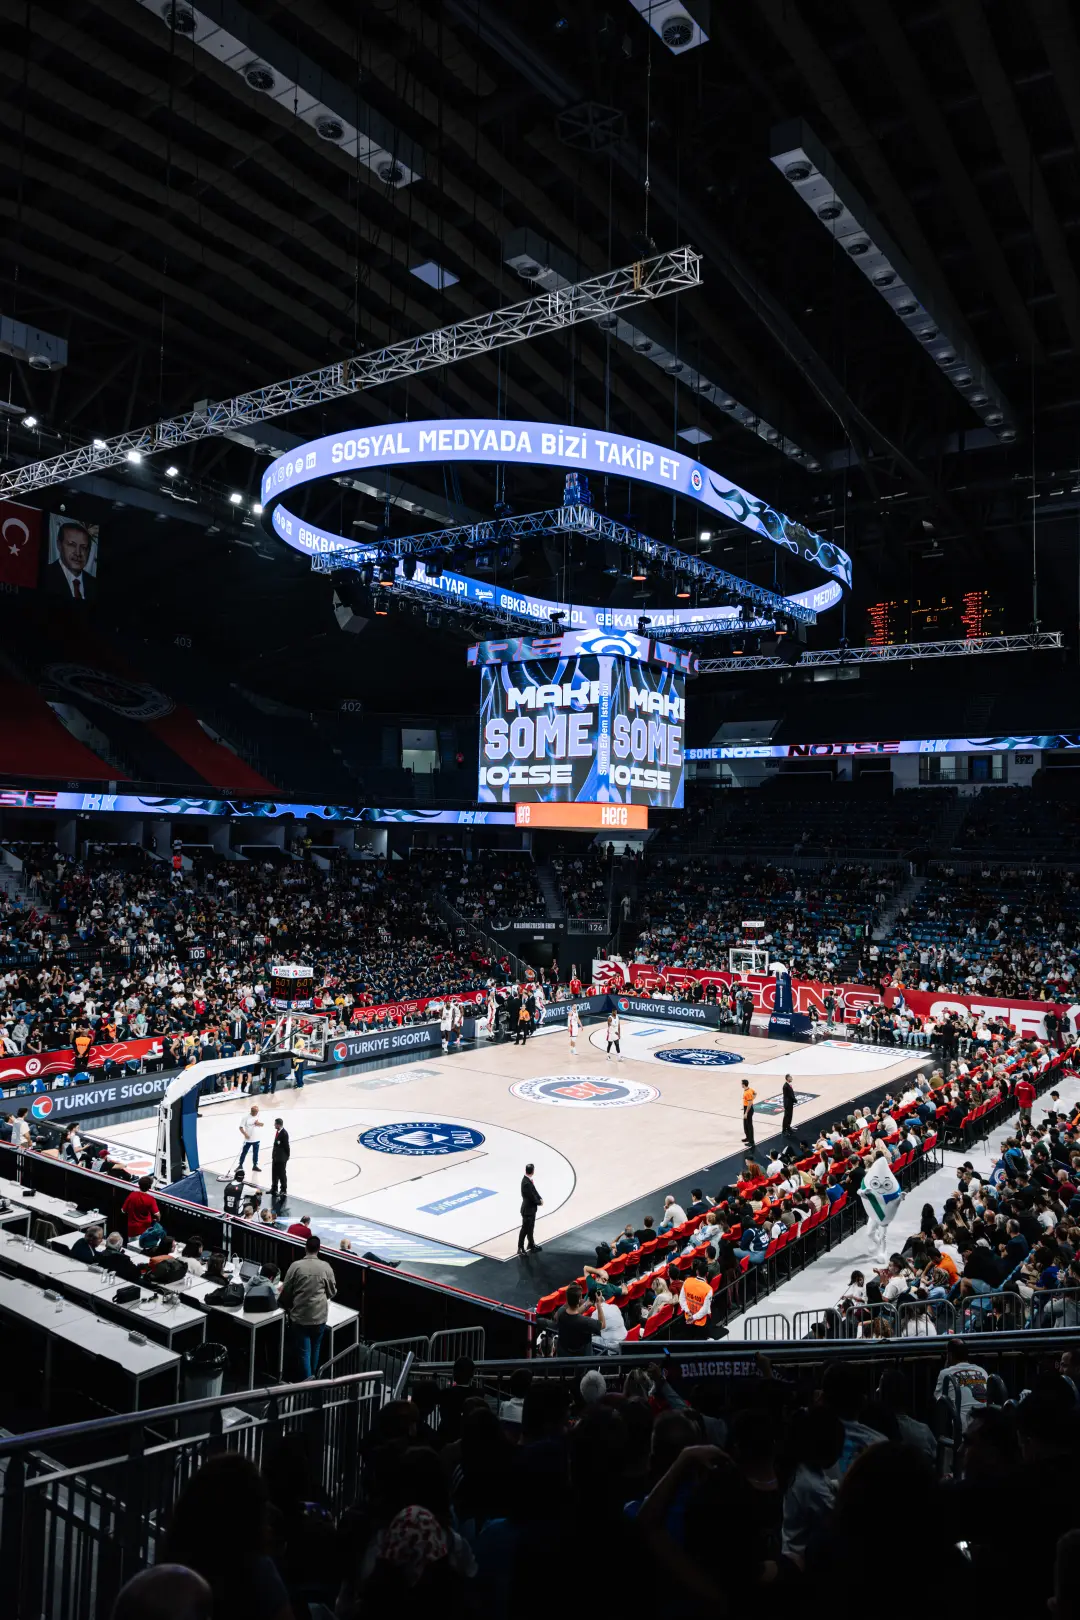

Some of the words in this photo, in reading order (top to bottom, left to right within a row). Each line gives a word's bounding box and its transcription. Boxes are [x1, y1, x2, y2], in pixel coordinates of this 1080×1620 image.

[332, 433, 410, 463] SOSYAL
[420, 429, 532, 453] MEDYADA
[660, 456, 680, 480] ET
[341, 702, 361, 712] 402
[486, 713, 594, 760] SOME
[600, 719, 608, 749] Erdem
[613, 714, 682, 767] SOME
[599, 750, 608, 775] Sinan
[788, 742, 899, 757] NOISE
[190, 949, 205, 959] 105
